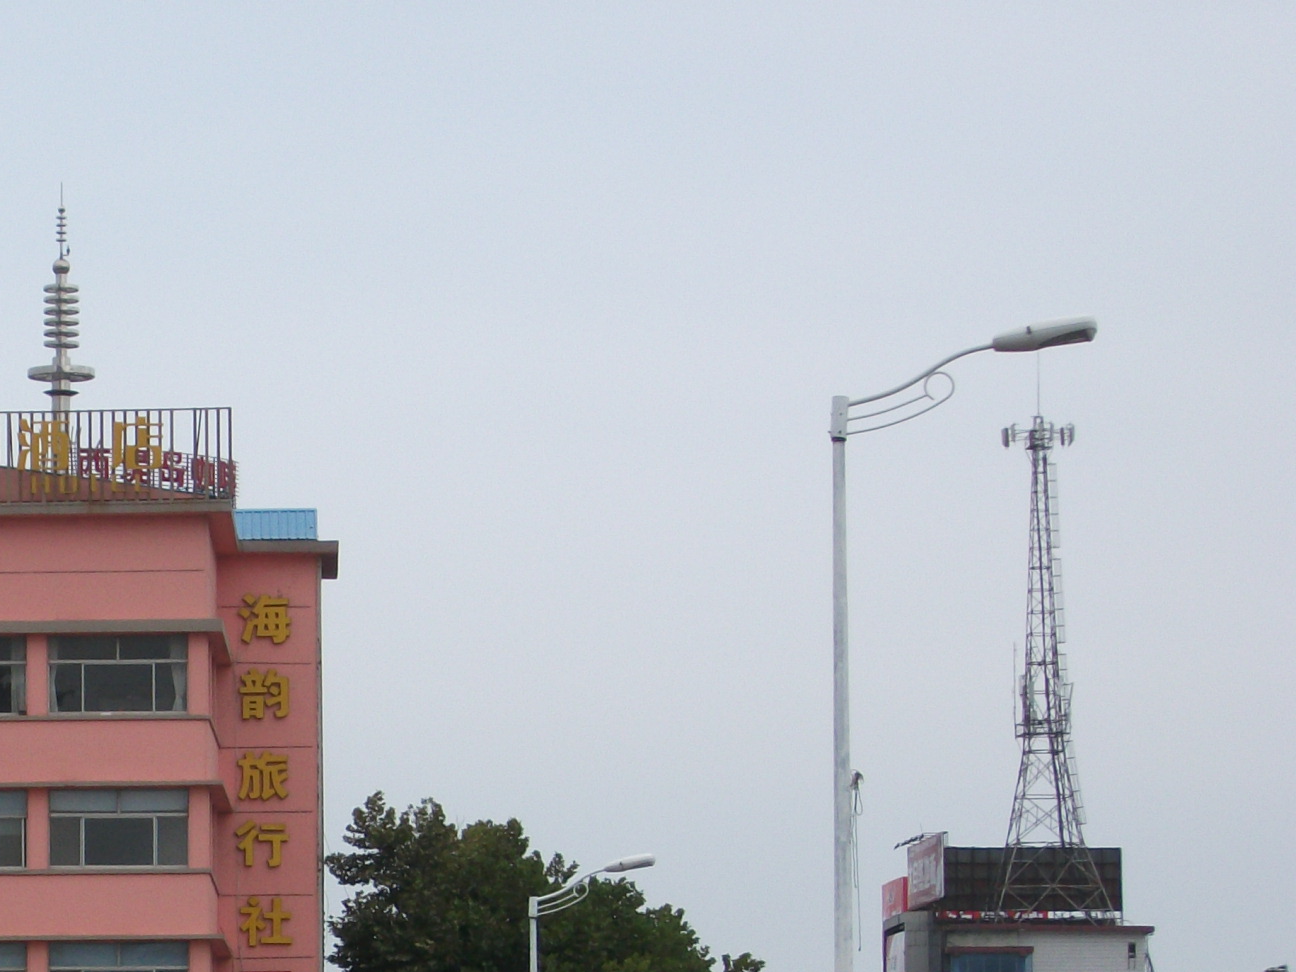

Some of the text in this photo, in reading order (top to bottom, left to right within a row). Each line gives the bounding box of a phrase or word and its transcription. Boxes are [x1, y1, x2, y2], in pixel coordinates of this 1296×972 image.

[236, 594, 294, 947] 海韵旅行社
